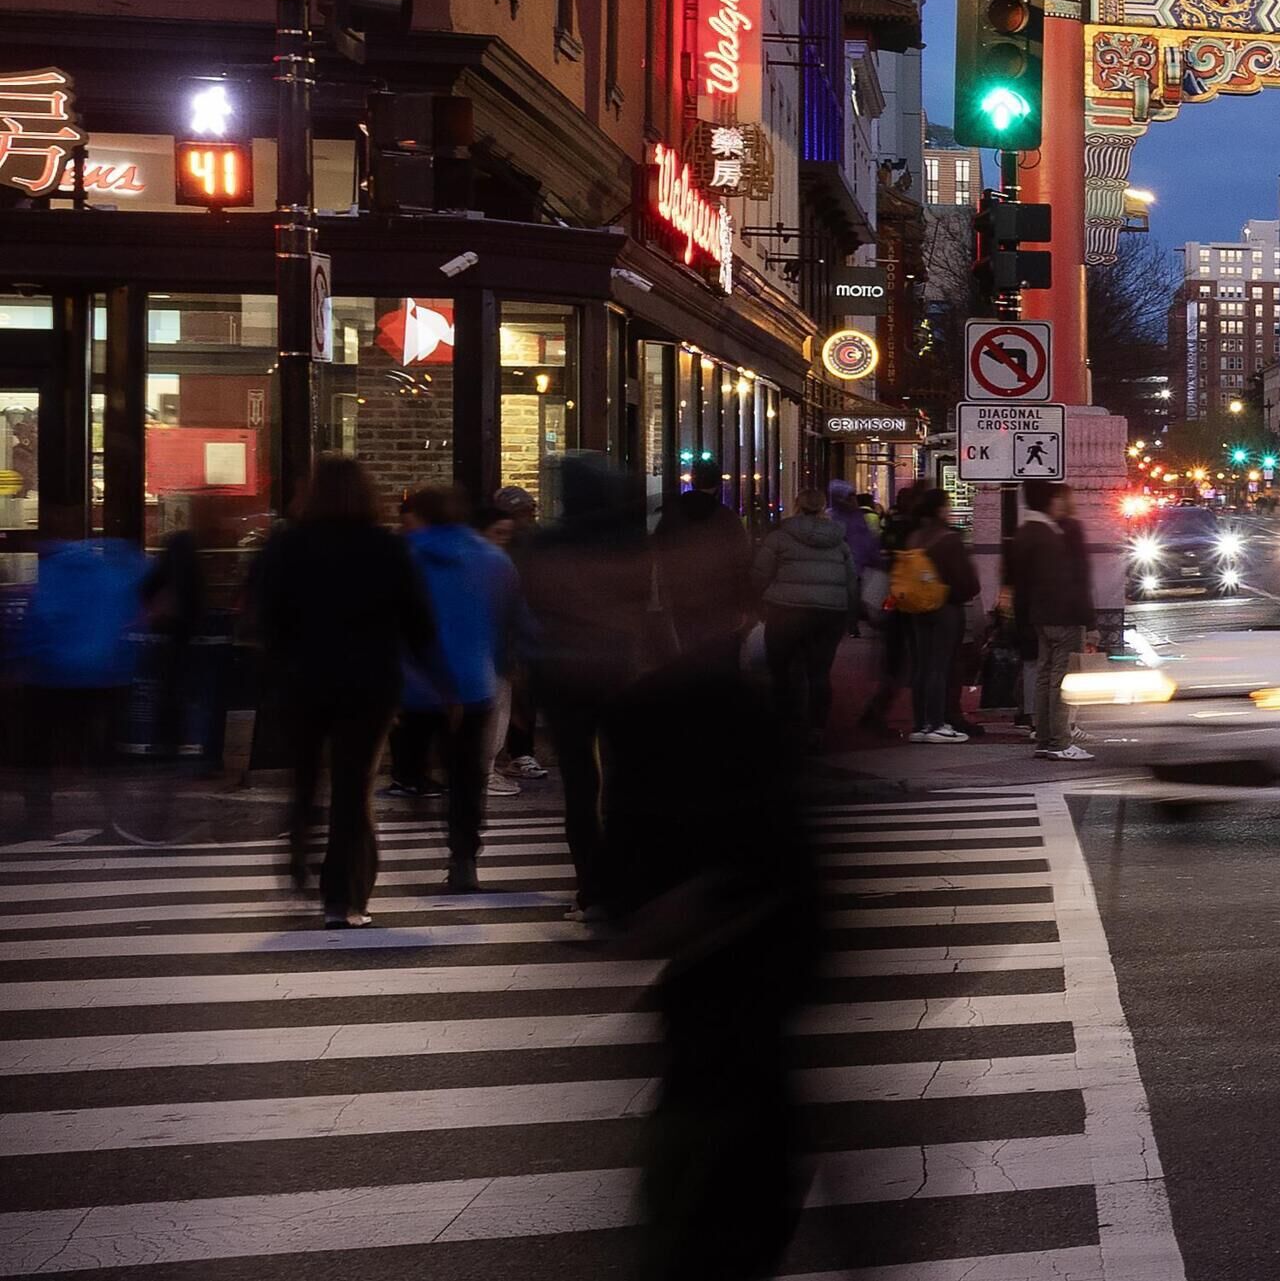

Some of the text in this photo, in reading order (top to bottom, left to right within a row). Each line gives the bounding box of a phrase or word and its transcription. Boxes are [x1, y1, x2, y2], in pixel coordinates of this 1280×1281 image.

[187, 151, 237, 196] 41
[836, 284, 884, 298] MOTTO
[979, 408, 1042, 419] DIAGONAL
[828, 418, 906, 432] CRIMSON
[977, 420, 1040, 431] CROSSING
